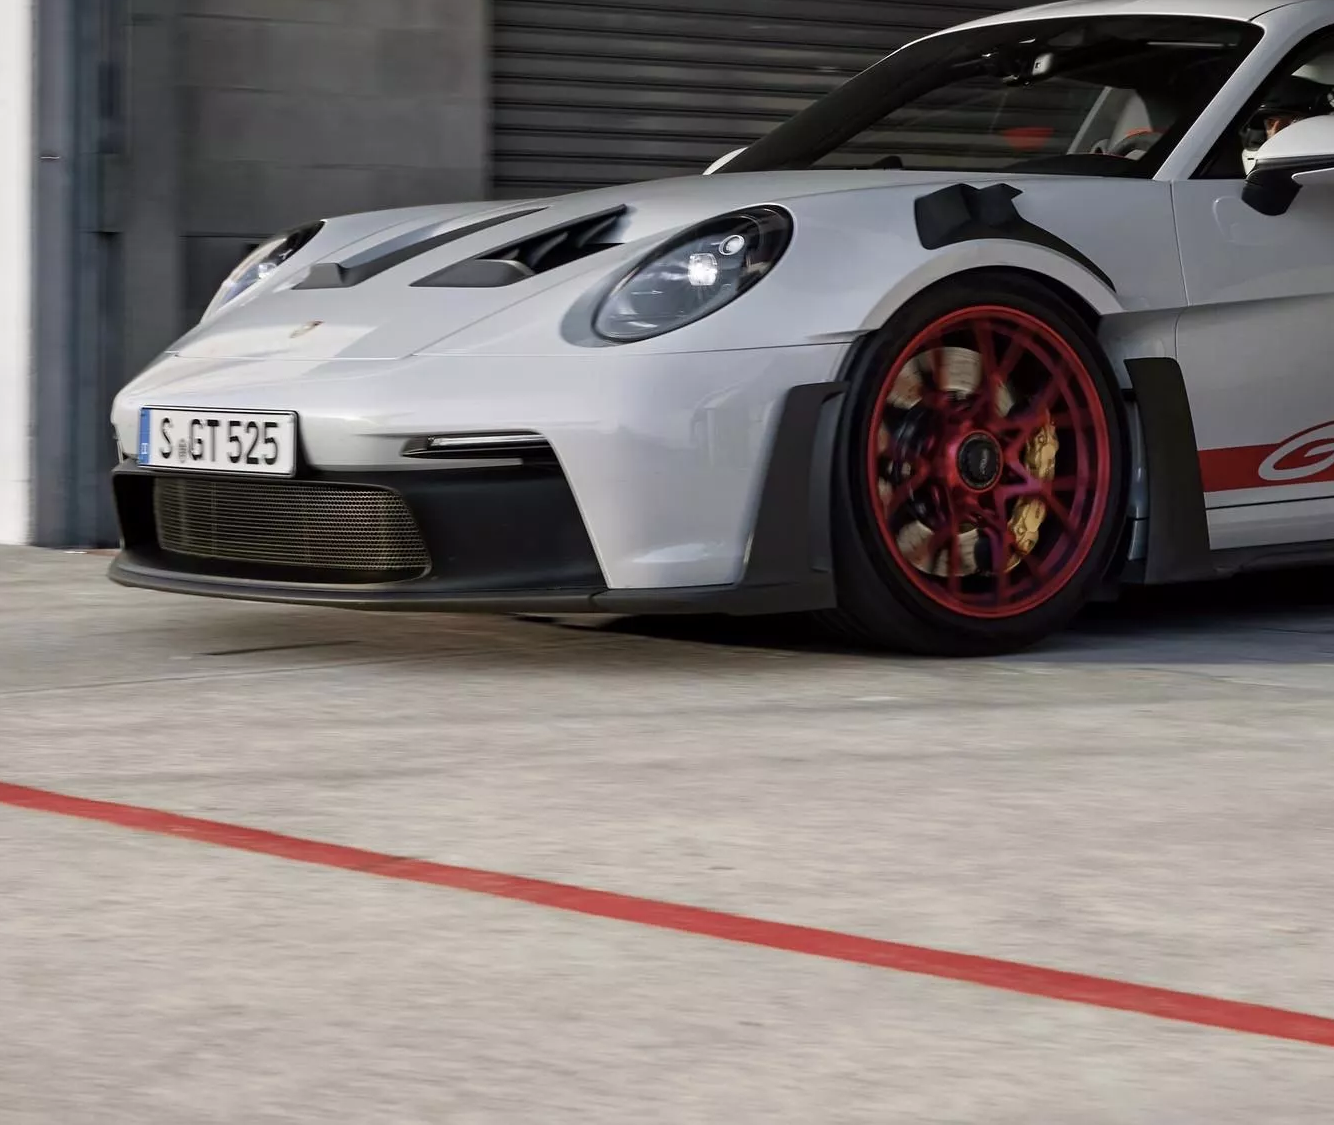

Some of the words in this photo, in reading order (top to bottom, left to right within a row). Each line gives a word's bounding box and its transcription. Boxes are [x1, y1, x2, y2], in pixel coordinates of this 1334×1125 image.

[160, 417, 173, 459] S
[189, 418, 219, 461] GT
[228, 420, 279, 465] 525
